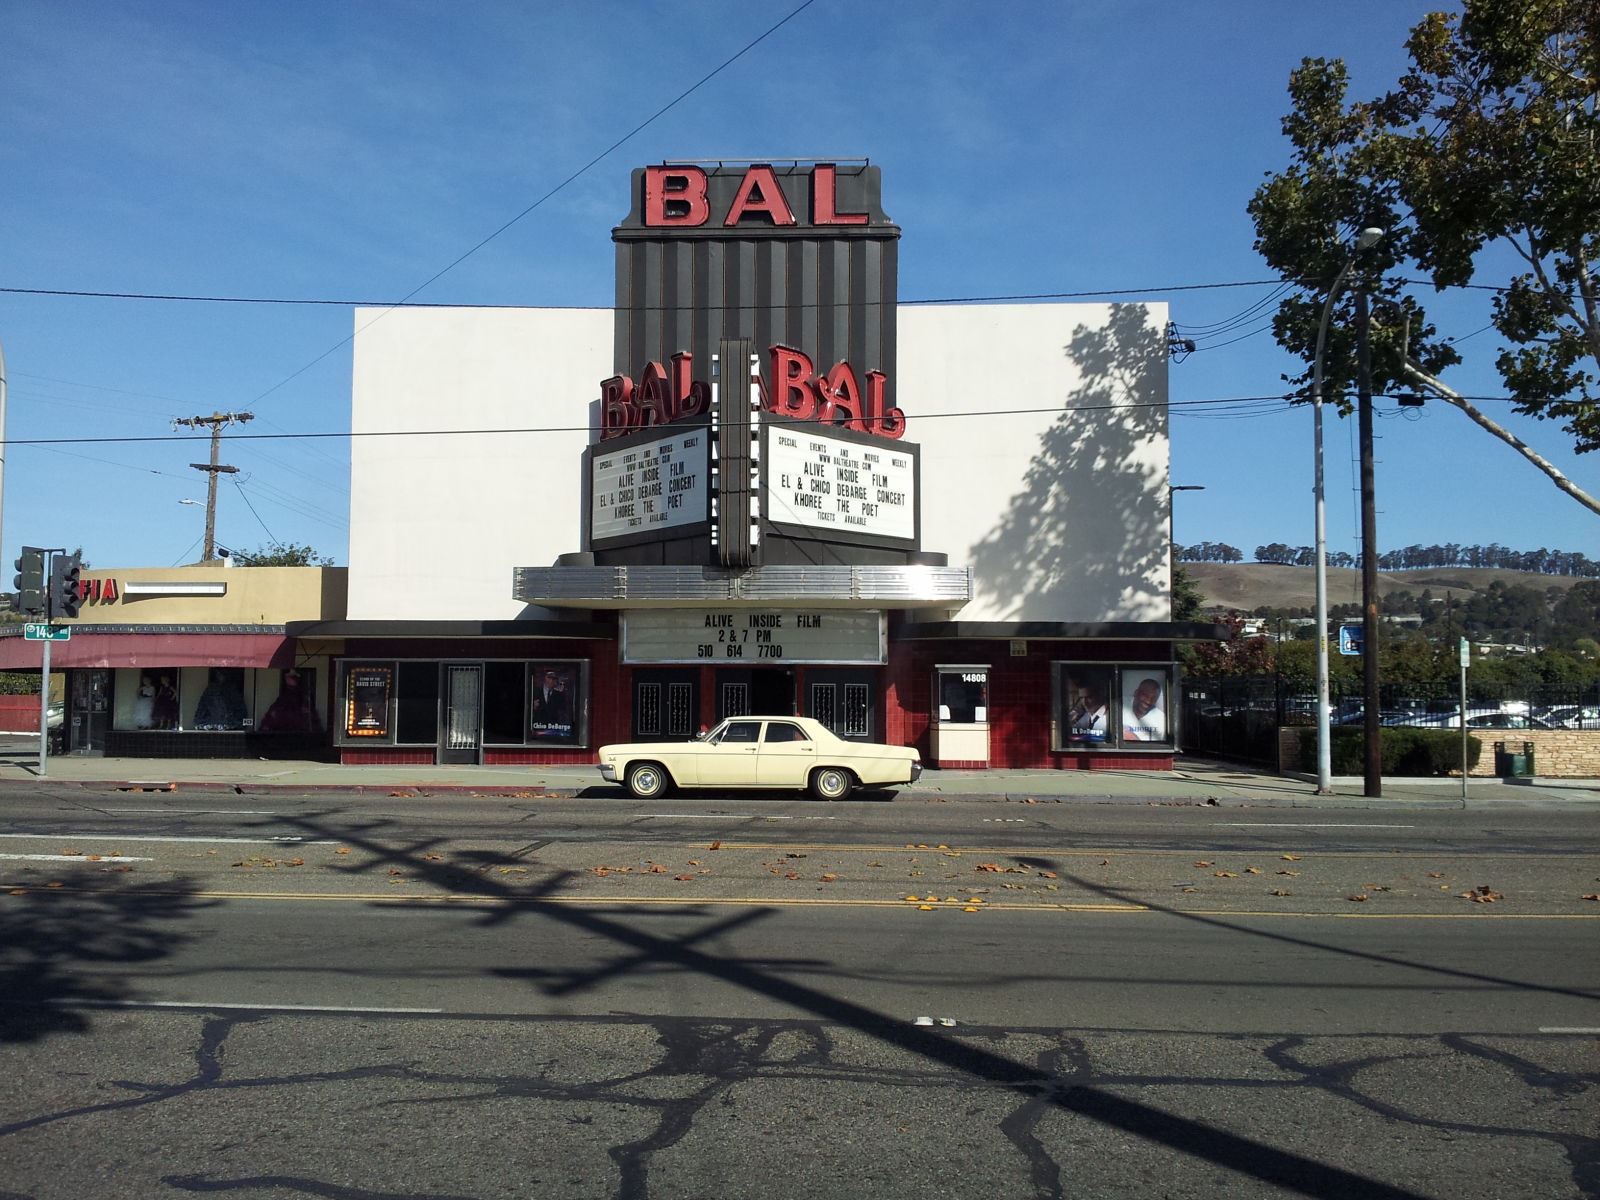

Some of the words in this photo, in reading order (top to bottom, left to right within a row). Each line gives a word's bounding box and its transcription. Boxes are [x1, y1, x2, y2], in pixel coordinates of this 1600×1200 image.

[645, 163, 870, 227] BAL
[599, 351, 711, 441] BAL
[768, 345, 906, 440] BAL
[600, 460, 612, 469] SPECIAL
[624, 454, 636, 463] EVENTS
[660, 444, 673, 455] MOVIES
[684, 437, 698, 449] WEEKLY
[627, 464, 636, 472] WWW
[662, 455, 670, 463] COM
[779, 436, 797, 448] SPECIAL
[810, 442, 826, 453] EVENTS
[840, 448, 848, 457] AND
[864, 453, 879, 463] MOVIES
[892, 458, 907, 468] WEEKLY
[819, 454, 830, 463] WWW
[833, 457, 859, 469] BALTHEATRE
[862, 462, 871, 471] COM
[619, 474, 634, 488] ALIVE
[642, 467, 659, 483] INSIDE
[670, 461, 684, 477] FILM
[804, 462, 824, 477] ALIVE
[837, 468, 858, 483] INSIDE
[872, 474, 888, 488] FILM
[601, 495, 606, 507] EL
[610, 494, 614, 505] &
[619, 488, 634, 503] CHICO
[638, 482, 662, 499] DEBARGE
[669, 475, 696, 493] CONCERT
[782, 474, 790, 488] EL
[797, 477, 803, 490] &
[811, 479, 830, 494] CHICO
[837, 483, 867, 500] DEBARGE
[877, 490, 905, 506] CONCERT
[615, 504, 634, 519] KHOREE
[643, 500, 653, 514] THE
[668, 494, 682, 509] POET
[795, 493, 822, 509] KHOREE
[837, 499, 849, 513] THE
[862, 504, 878, 517] POET
[628, 517, 642, 527] TICKETS
[650, 512, 668, 523] AVAILABLE
[818, 511, 835, 522] TICKETS
[845, 515, 866, 526] AVAILABLE
[705, 614, 733, 628] ALIVE
[750, 614, 781, 628] INSIDE
[797, 614, 821, 628] FILM
[718, 630, 725, 643] 2
[729, 630, 737, 643] &
[742, 630, 748, 643] 7
[756, 630, 771, 643] PM
[698, 644, 713, 657] 510
[726, 644, 742, 657] 614
[758, 644, 782, 657] 7700
[962, 673, 987, 683] 14808
